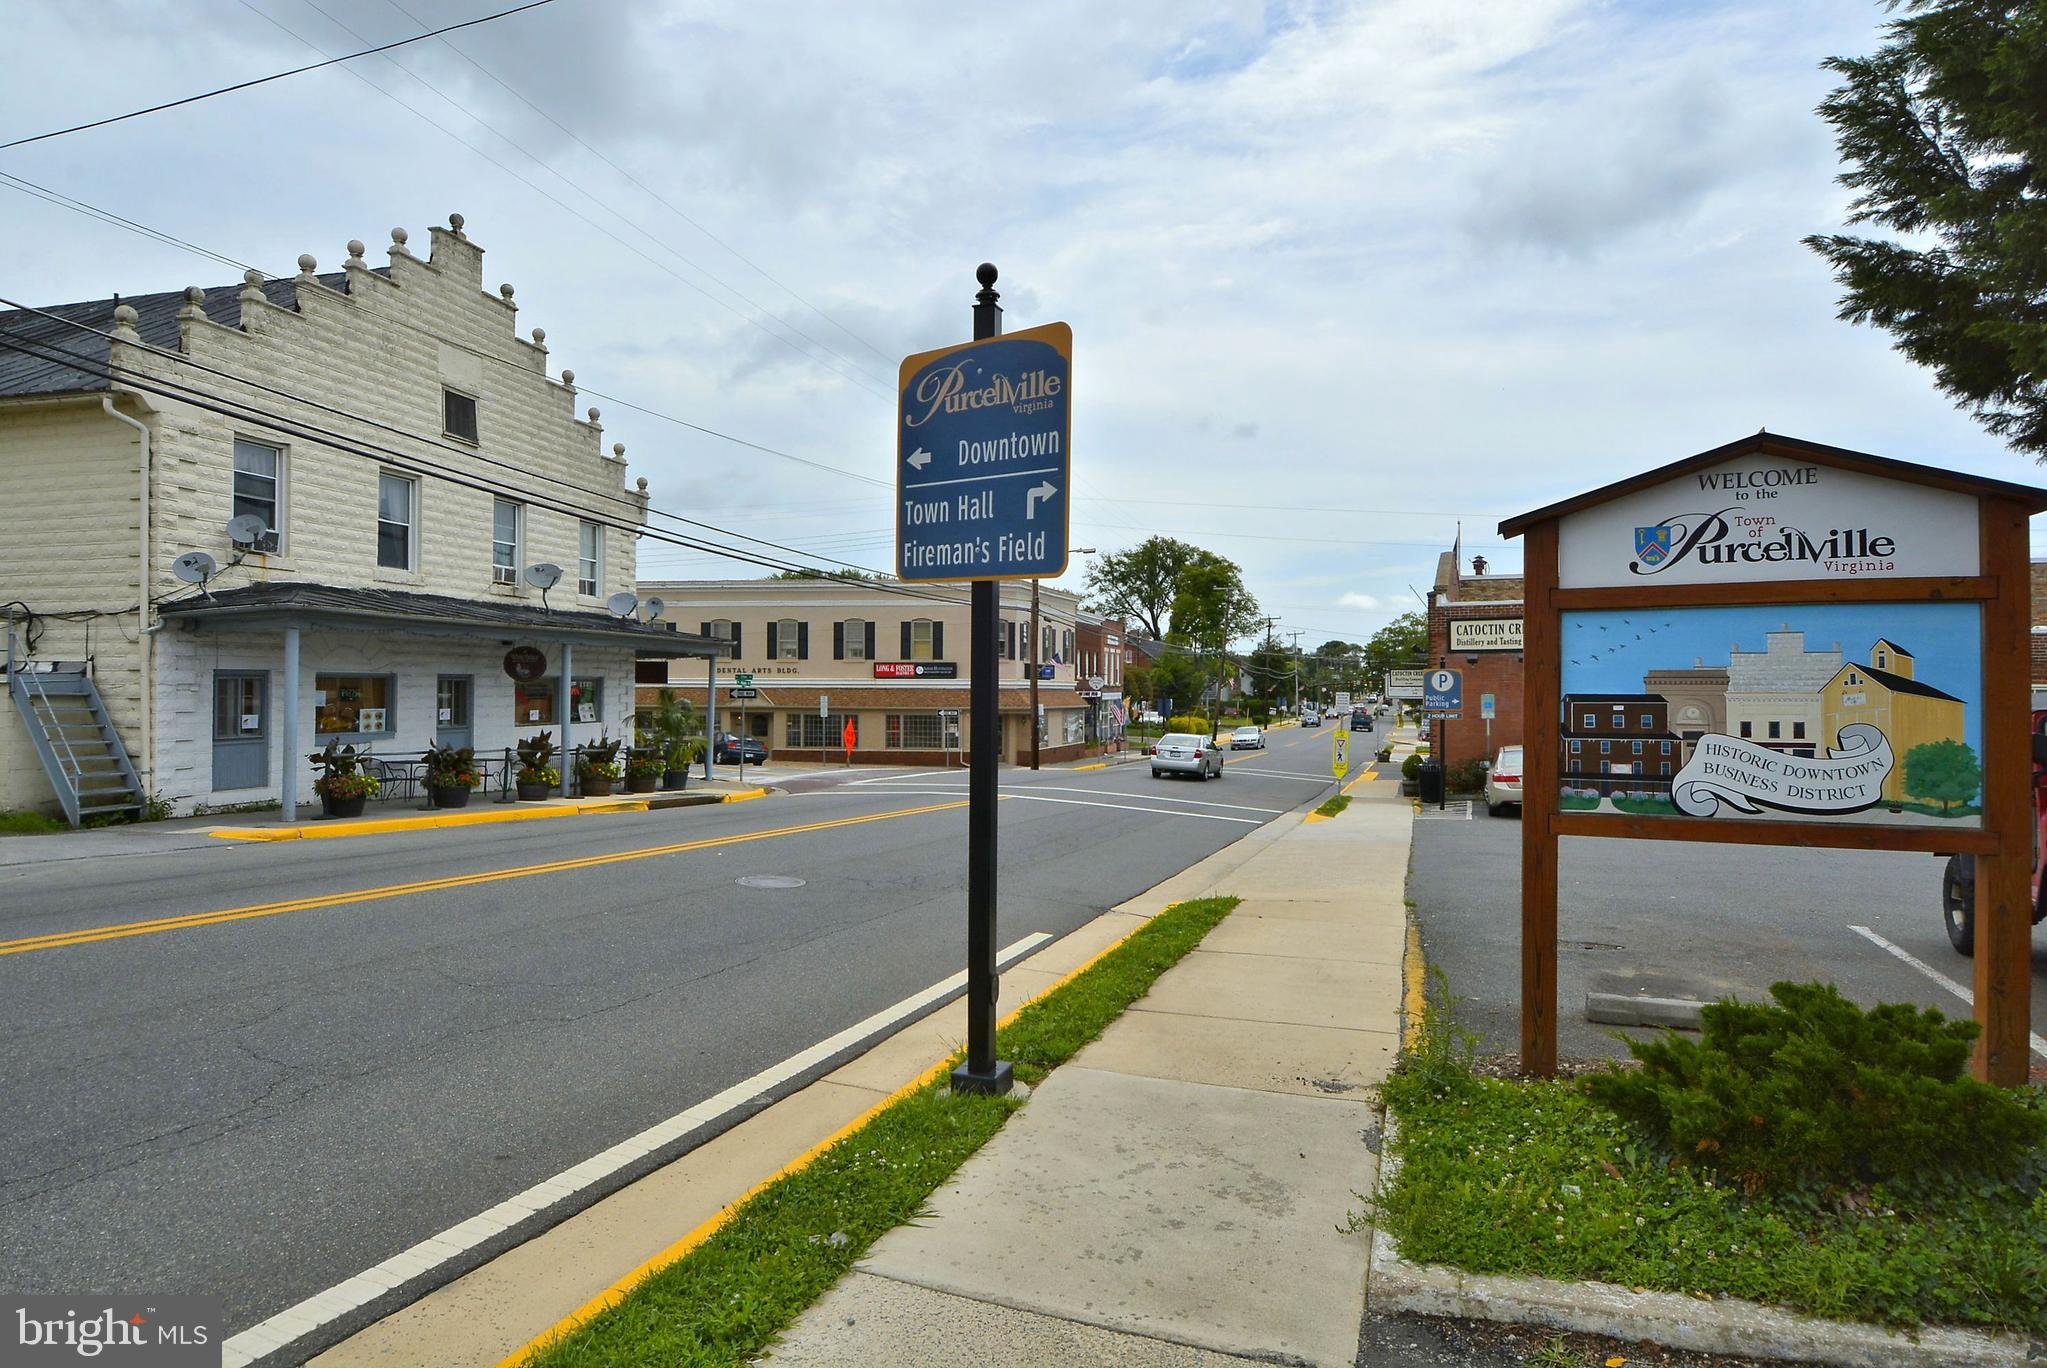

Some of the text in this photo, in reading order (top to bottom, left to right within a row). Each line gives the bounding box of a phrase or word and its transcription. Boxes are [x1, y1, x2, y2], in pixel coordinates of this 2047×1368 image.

[905, 359, 1061, 427] Purcellville
[1013, 399, 1055, 415] virginia
[958, 431, 1059, 466] Downtown
[1698, 468, 1818, 491] WELCOME
[1736, 489, 1778, 501] to the
[905, 490, 994, 525] Town Hall
[1735, 516, 1776, 527] Town
[1748, 527, 1764, 538] of
[904, 531, 1045, 567] Fireman's Field
[1629, 507, 1896, 575] Purcellville
[1824, 560, 1894, 575] Virginia
[1456, 623, 1522, 636] CATOCTIN CR
[1456, 637, 1522, 647] Distillery and Tasting
[875, 664, 890, 672] LONG
[1439, 673, 1448, 688] P
[1706, 744, 1885, 781] HISTORIC DOWNTOWN
[1703, 762, 1866, 801] BUSINESS DISTRICT
